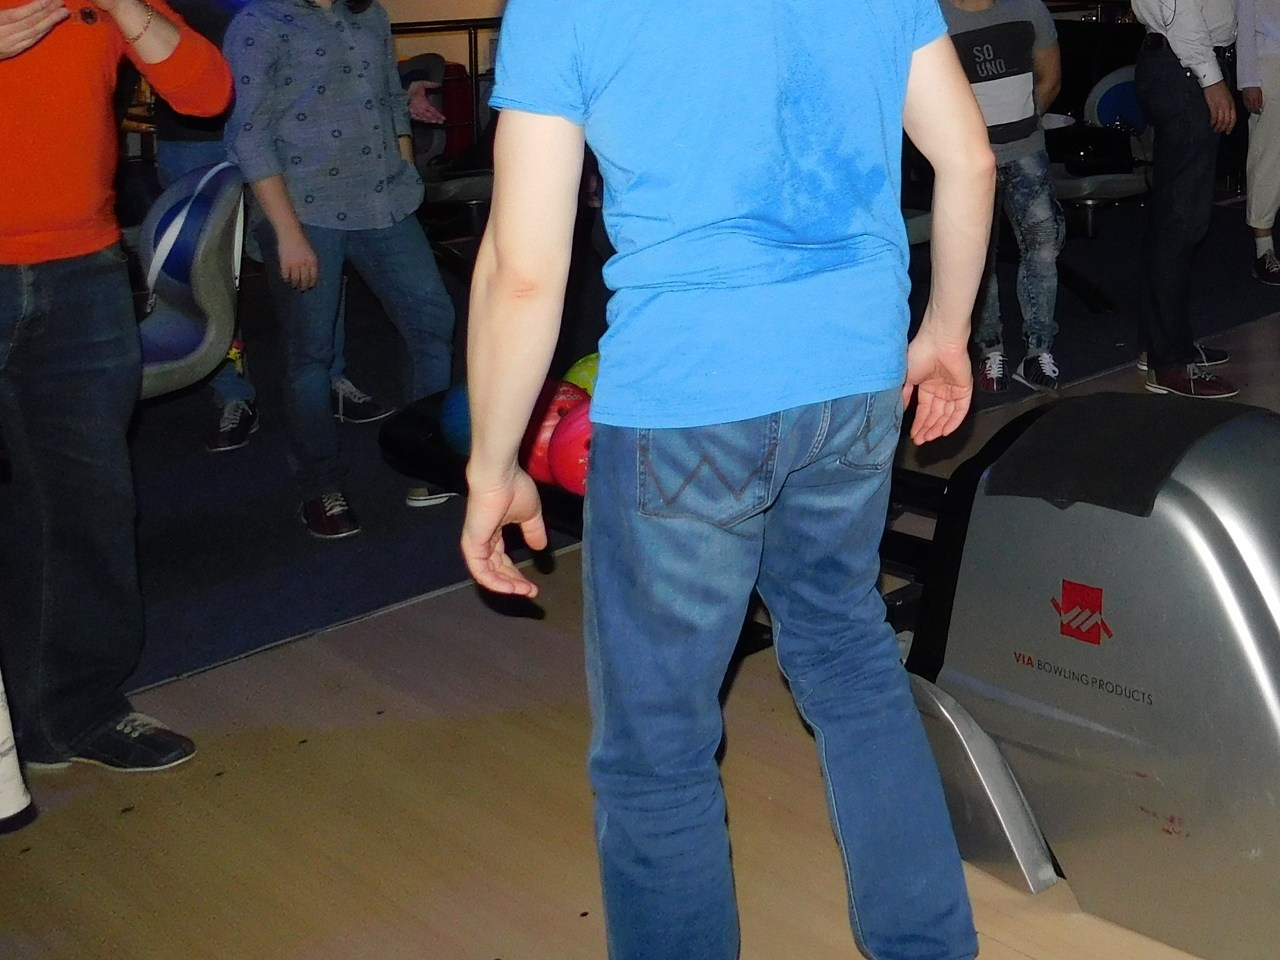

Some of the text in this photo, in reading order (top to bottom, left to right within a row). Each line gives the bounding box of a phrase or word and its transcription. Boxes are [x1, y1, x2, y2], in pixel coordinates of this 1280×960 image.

[973, 44, 994, 62] SO
[1013, 651, 1153, 706] VIA BOWLING PRODUCTS
